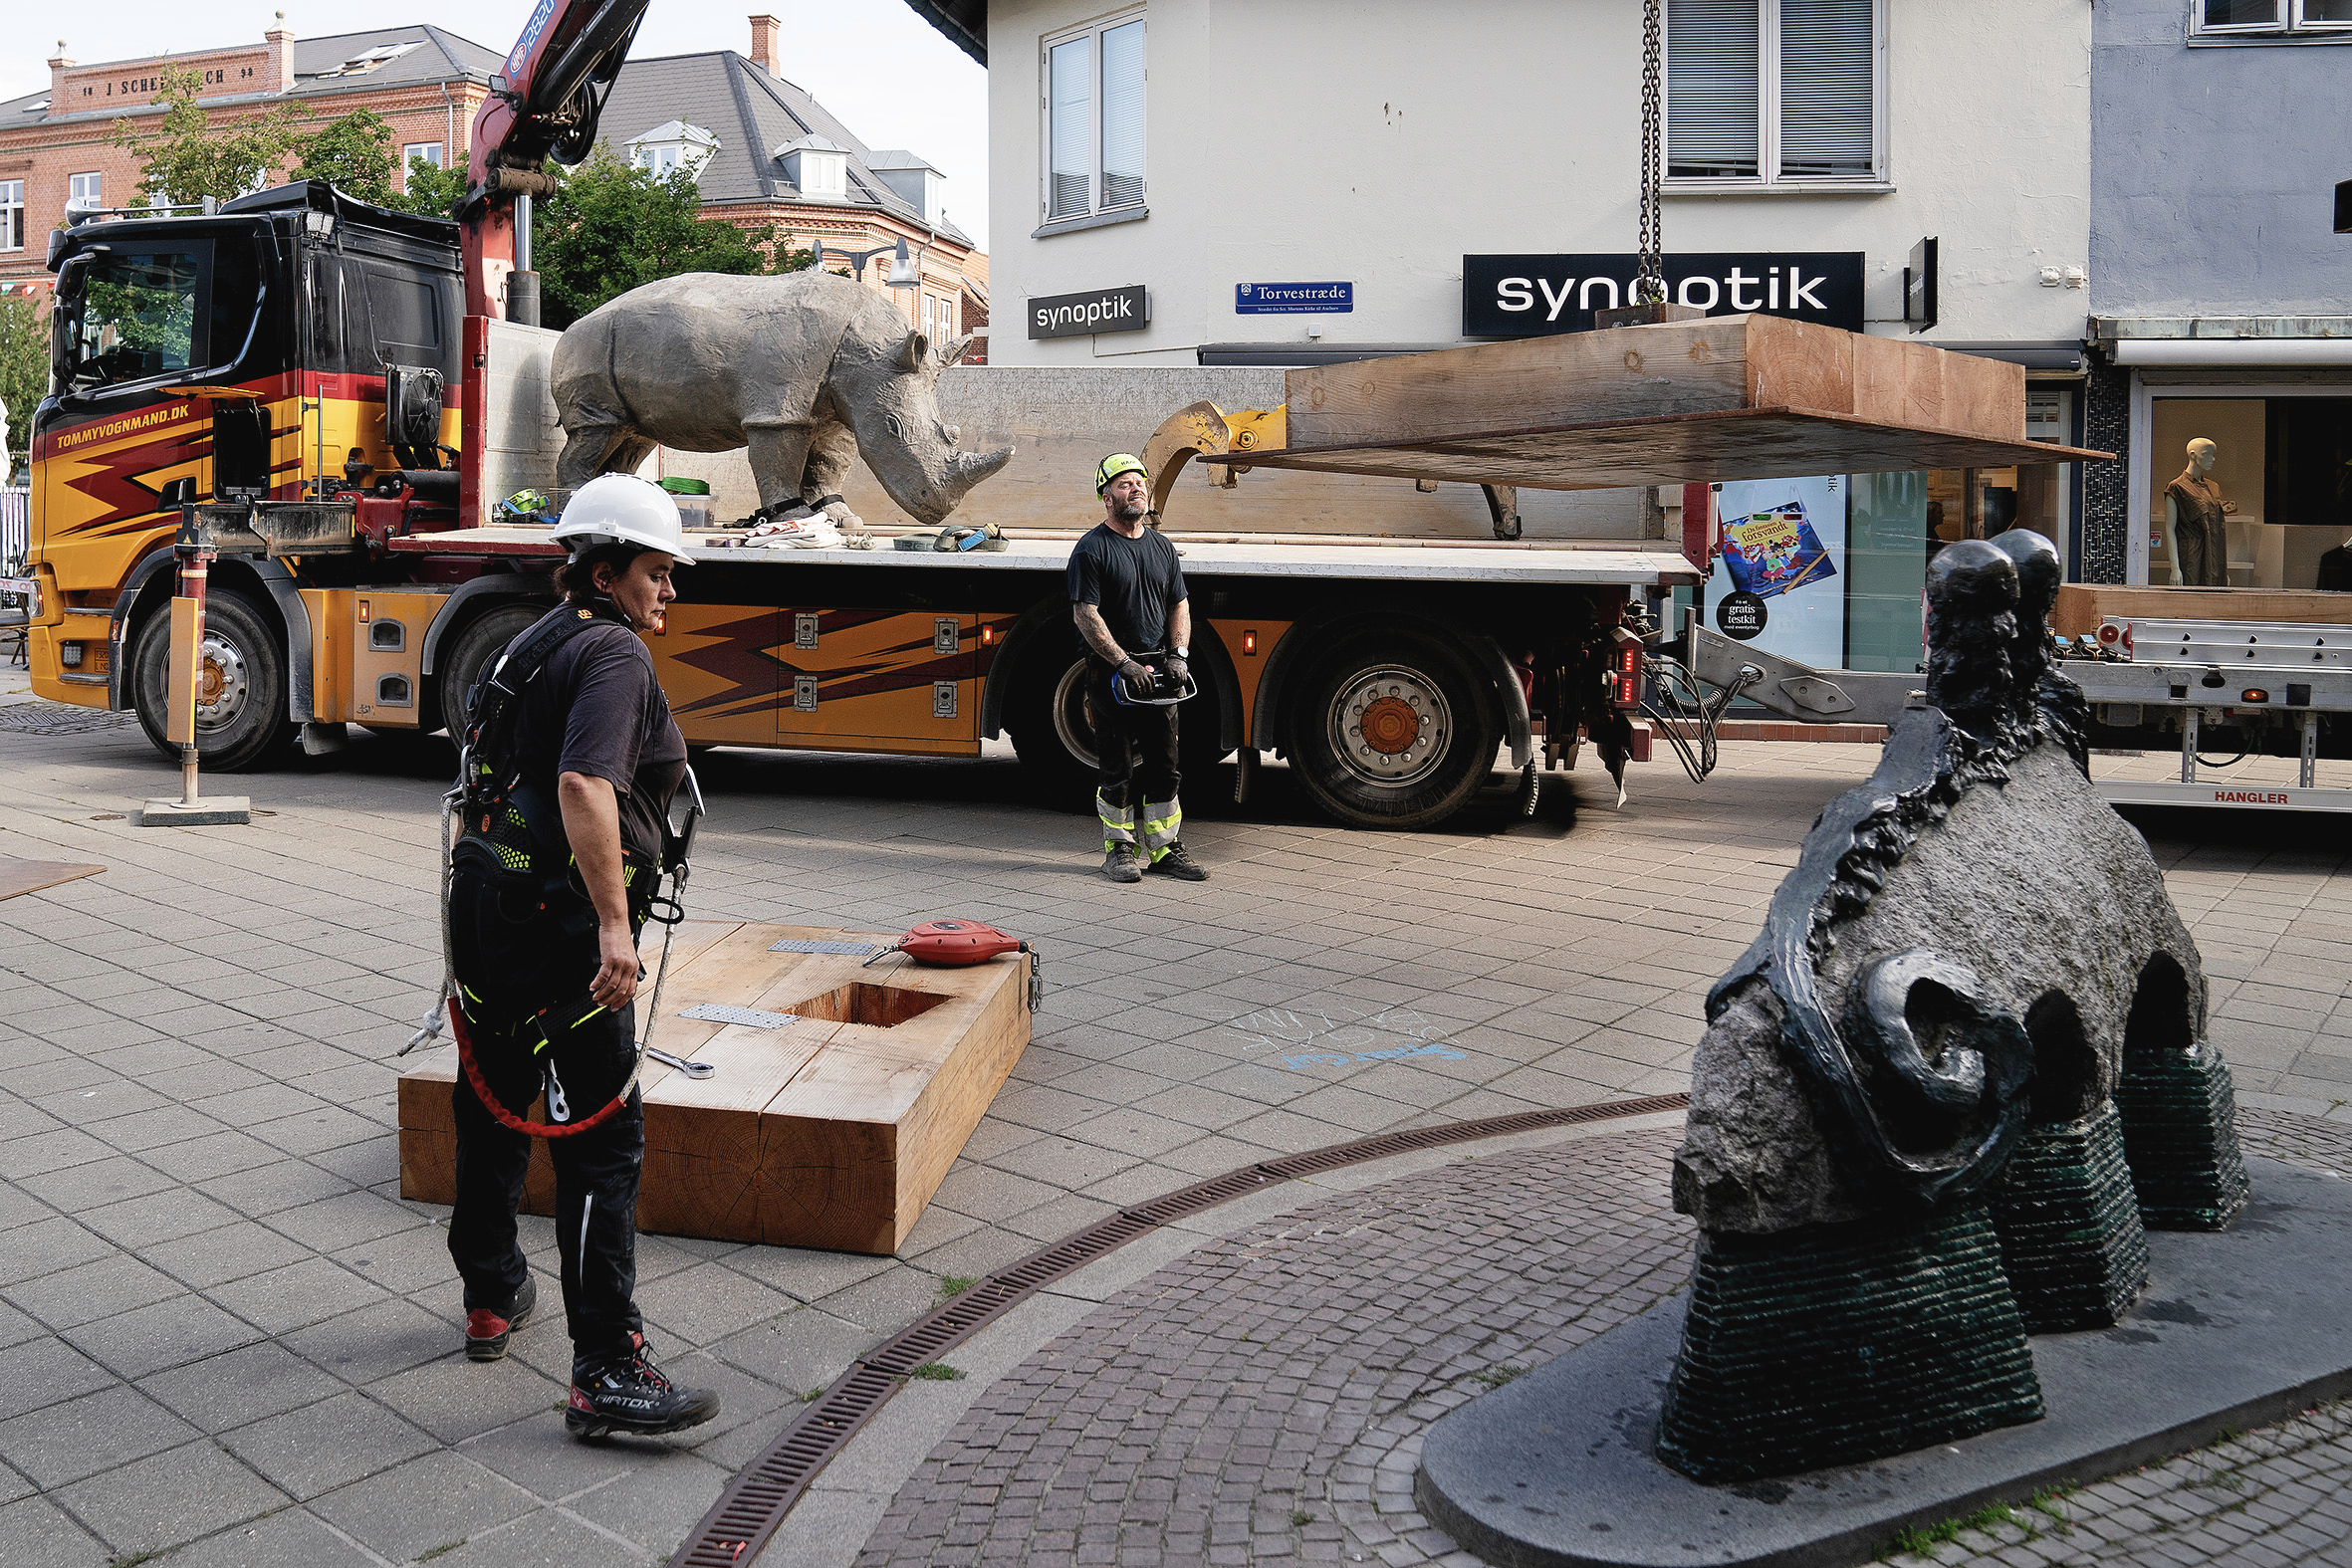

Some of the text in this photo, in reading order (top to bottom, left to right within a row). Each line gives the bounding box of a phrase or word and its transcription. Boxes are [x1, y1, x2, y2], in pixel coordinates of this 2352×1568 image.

[526, 0, 554, 47] 2820
[107, 83, 112, 96] J
[1258, 285, 1346, 300] Torvestræde
[1037, 294, 1132, 331] synoptik
[57, 404, 189, 449] TOMMYVOGNMAND.DK
[1827, 475, 1838, 492] tik
[1742, 521, 1788, 543] forsvandt
[1729, 603, 1756, 615] gratis
[1728, 614, 1756, 624] testkit
[2215, 790, 2288, 804] HANGLER
[595, 1394, 654, 1411] AIRTOX
